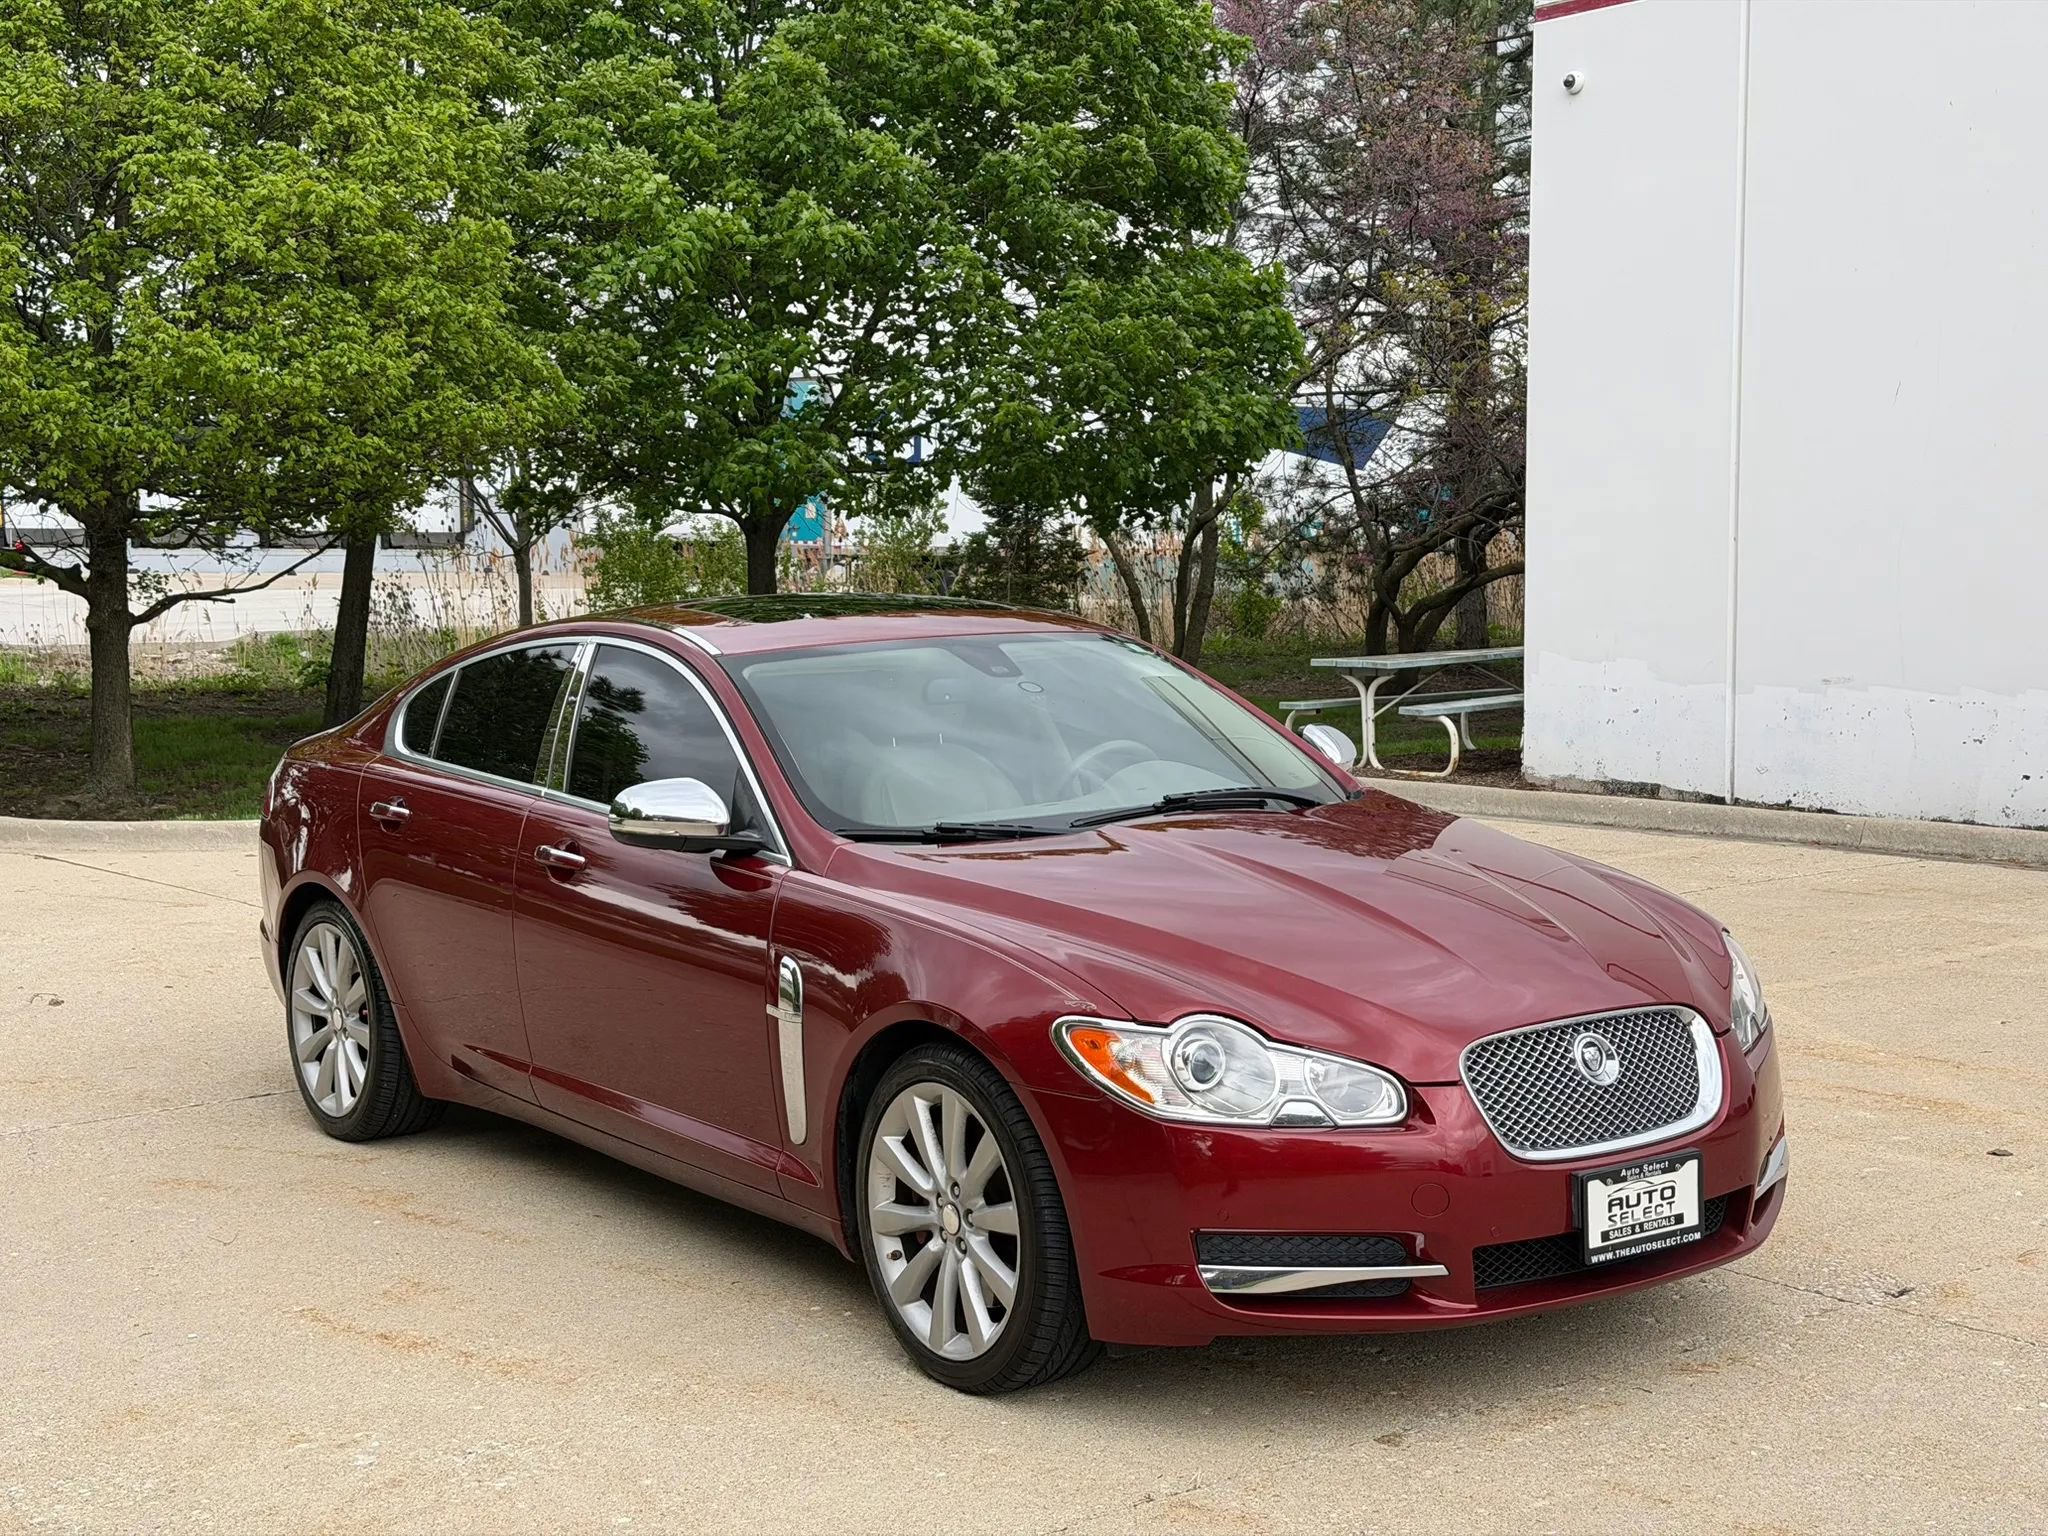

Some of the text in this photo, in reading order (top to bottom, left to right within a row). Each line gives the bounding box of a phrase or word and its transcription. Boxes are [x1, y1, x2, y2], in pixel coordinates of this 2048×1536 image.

[1620, 1161, 1669, 1177] Auto Select
[1608, 1185, 1676, 1213] AUTO
[1608, 1200, 1676, 1227] SELECT
[1609, 1216, 1675, 1239] SALES & RENTALS
[1591, 1232, 1701, 1263] WWW.THEAUTOSELECT.COM
